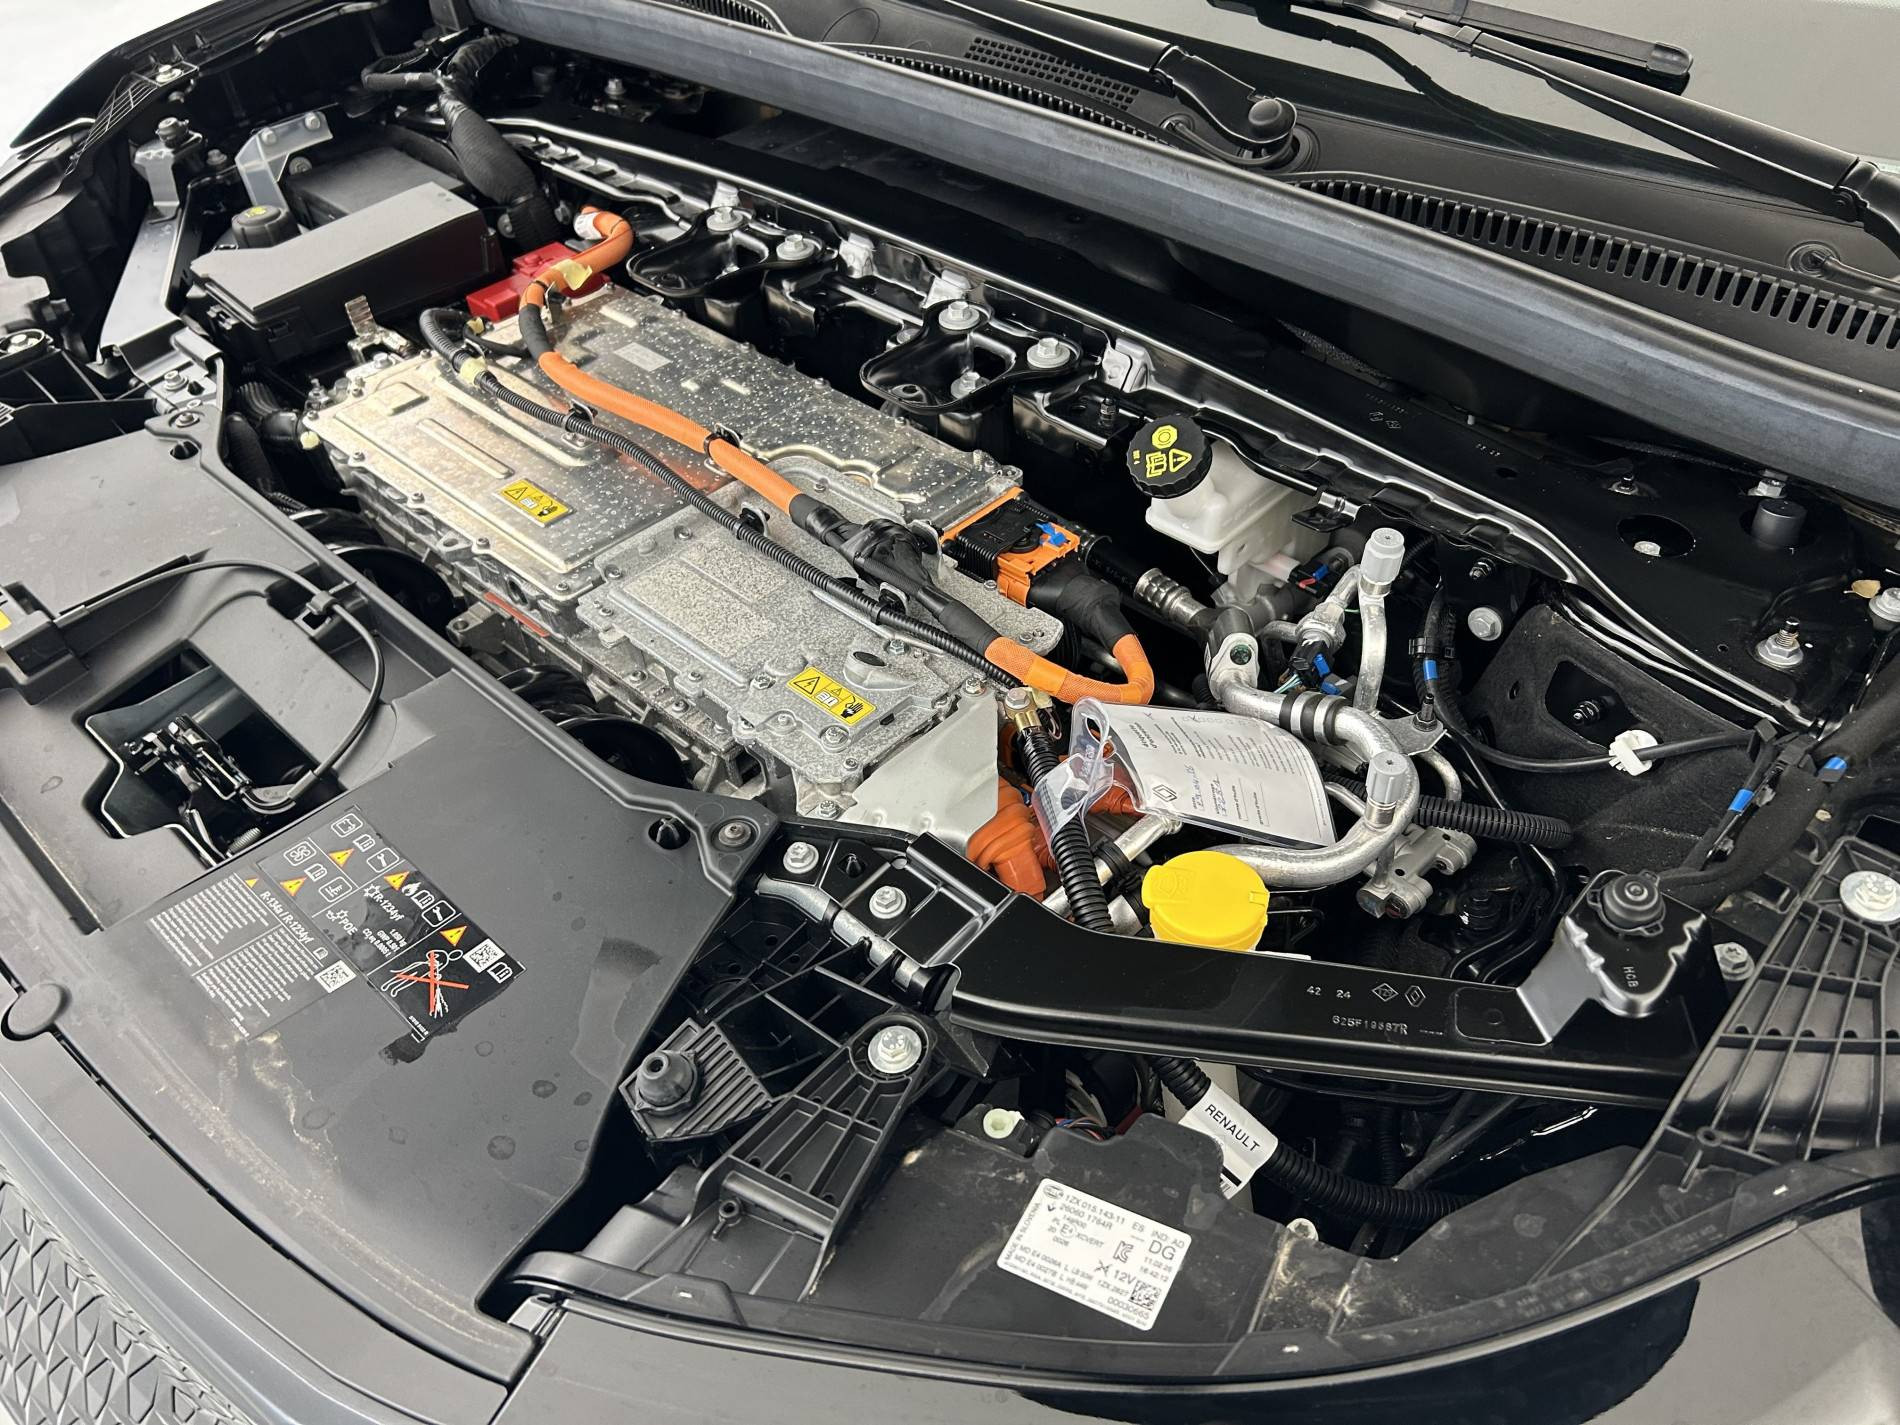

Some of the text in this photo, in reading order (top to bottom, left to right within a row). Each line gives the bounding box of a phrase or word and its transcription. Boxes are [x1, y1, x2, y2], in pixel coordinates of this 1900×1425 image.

[372, 891, 405, 922] R-1234yf
[260, 891, 284, 914] R-134a
[283, 913, 315, 945] R-1234yf
[339, 917, 359, 936] POE
[1306, 985, 1351, 1000] 42 24
[1204, 1103, 1261, 1152] RENAULT
[1148, 1239, 1176, 1261] DG
[1114, 1269, 1137, 1285] 12V
